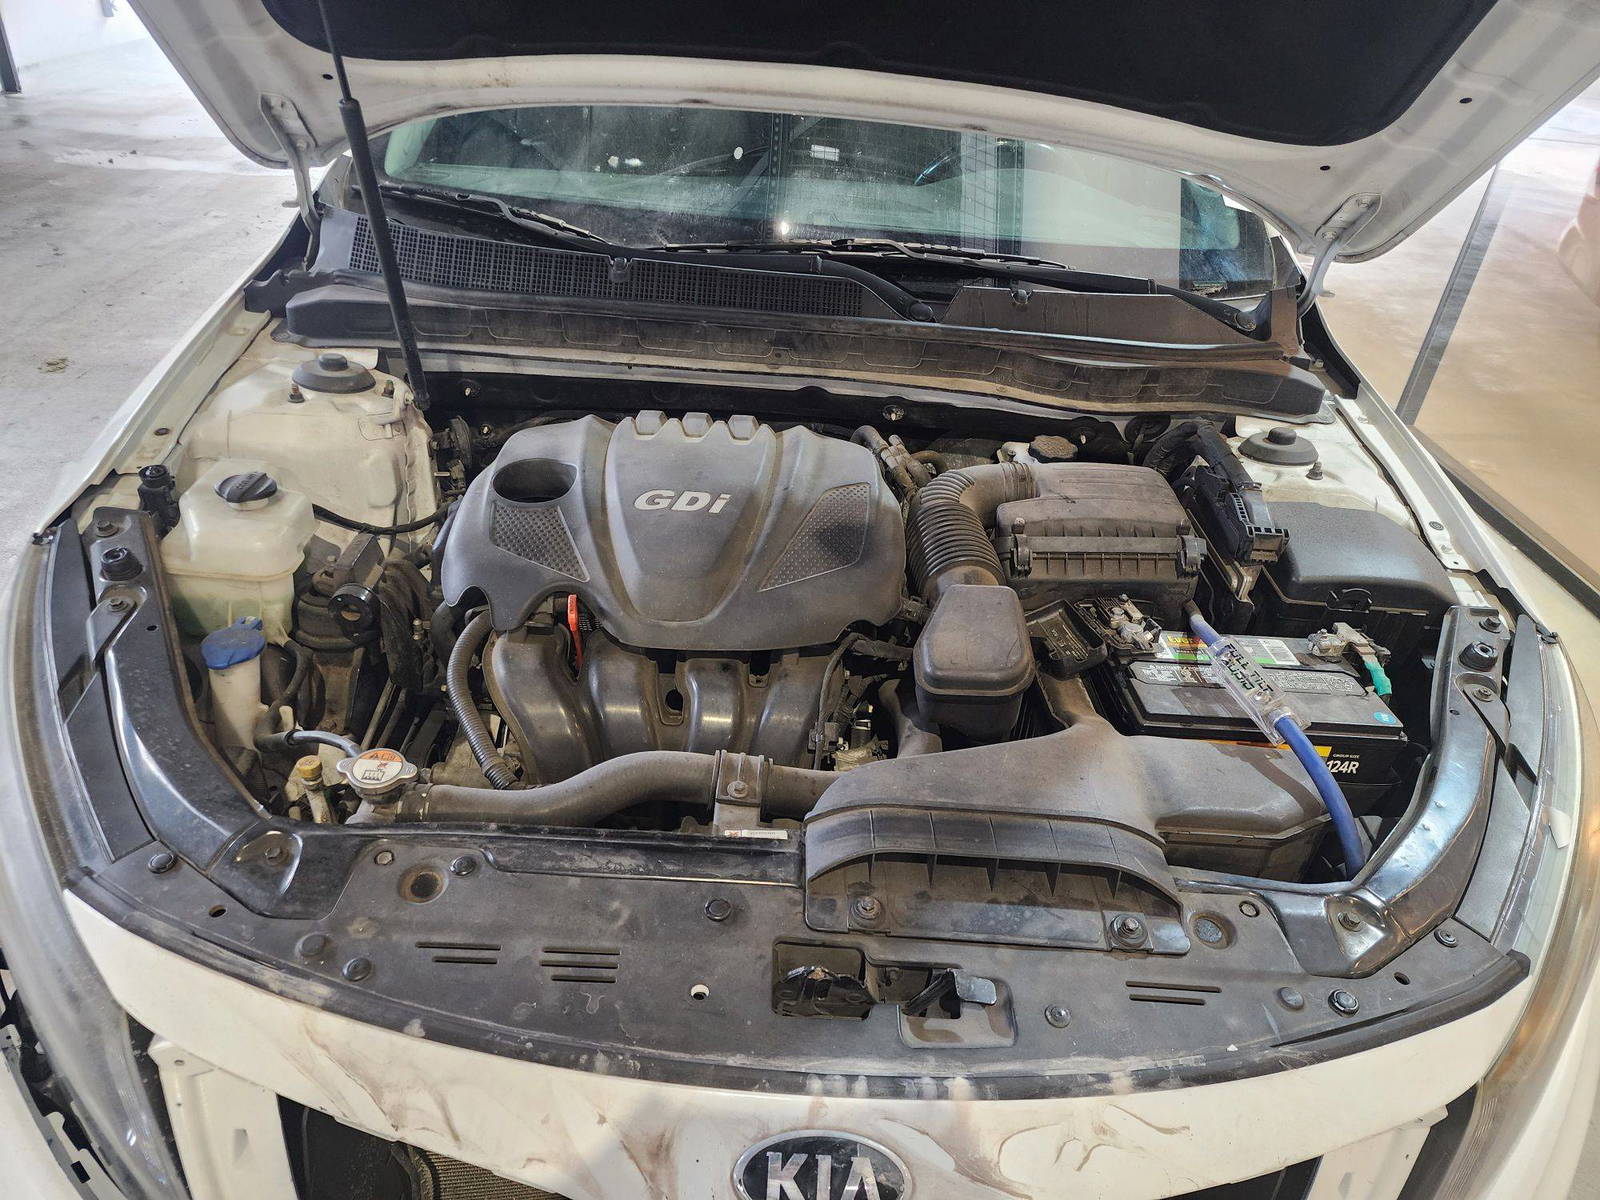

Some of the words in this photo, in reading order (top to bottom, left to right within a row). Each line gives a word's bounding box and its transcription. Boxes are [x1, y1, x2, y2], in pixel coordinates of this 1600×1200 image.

[633, 489, 732, 514] GDi
[1220, 658, 1255, 690] AUDIO
[1223, 643, 1249, 670] FULL
[1251, 670, 1274, 691] TILT
[766, 1151, 881, 1200] KIA
